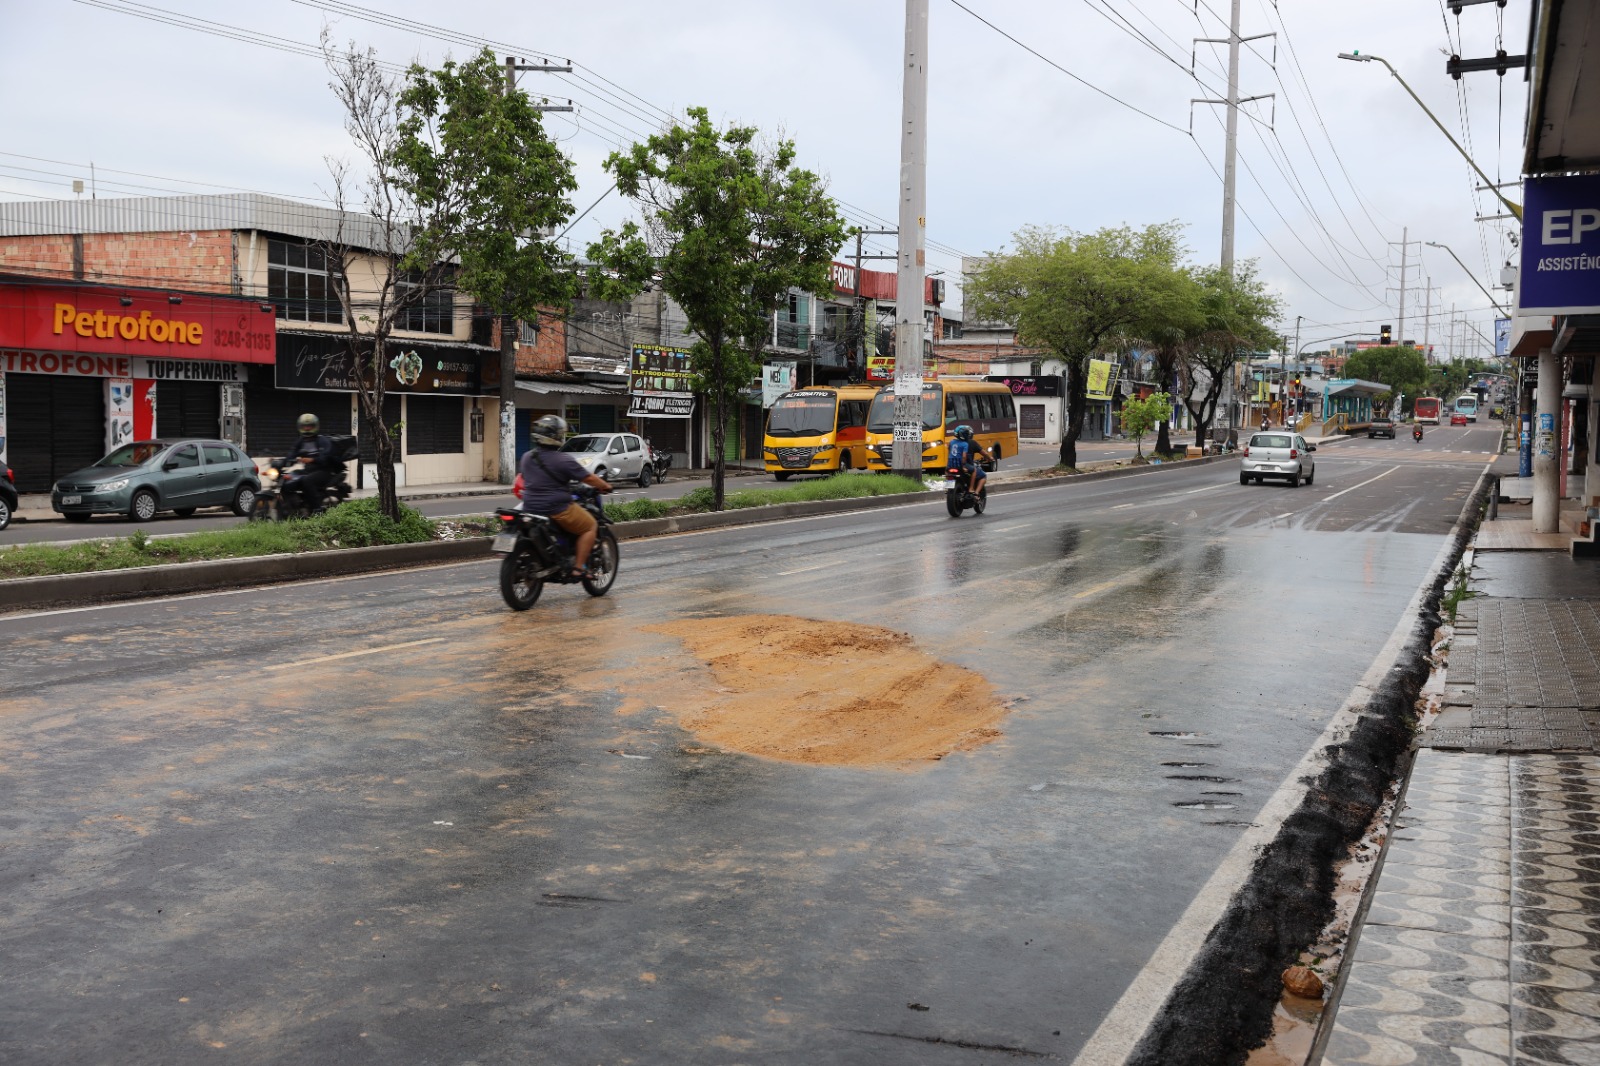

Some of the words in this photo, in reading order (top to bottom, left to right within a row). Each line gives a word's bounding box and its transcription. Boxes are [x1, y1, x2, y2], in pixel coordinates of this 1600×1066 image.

[52, 303, 203, 346] Petrofone
[214, 328, 272, 350] 3248-3135
[0, 351, 130, 377] TROFONE
[145, 359, 238, 381] TUPPERWARE
[325, 377, 342, 387] Buffet
